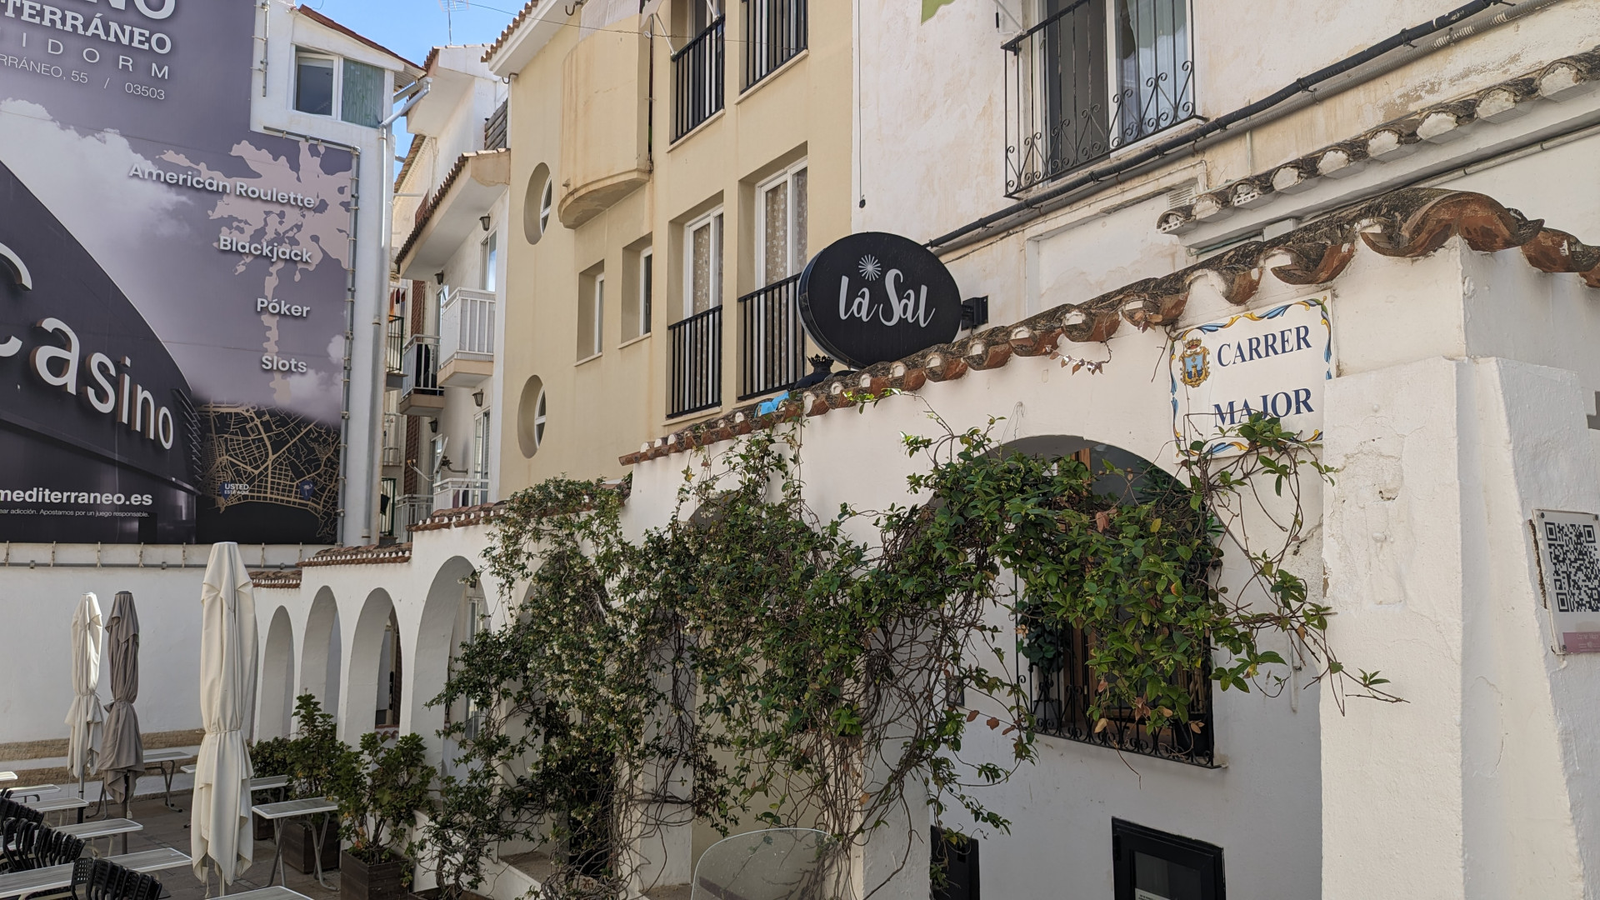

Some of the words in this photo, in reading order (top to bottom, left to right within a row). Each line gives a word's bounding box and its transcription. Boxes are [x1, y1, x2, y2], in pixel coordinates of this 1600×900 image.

[71, 70, 88, 84] 55
[125, 82, 166, 100] 03503
[128, 164, 231, 194] American
[236, 181, 315, 209] Roulette
[219, 235, 312, 263] Blackjack
[256, 297, 311, 318] Póker
[879, 268, 936, 328] Sal
[1217, 325, 1312, 367] CARRER
[261, 355, 307, 373] Slots
[1212, 388, 1314, 428] MAJOR
